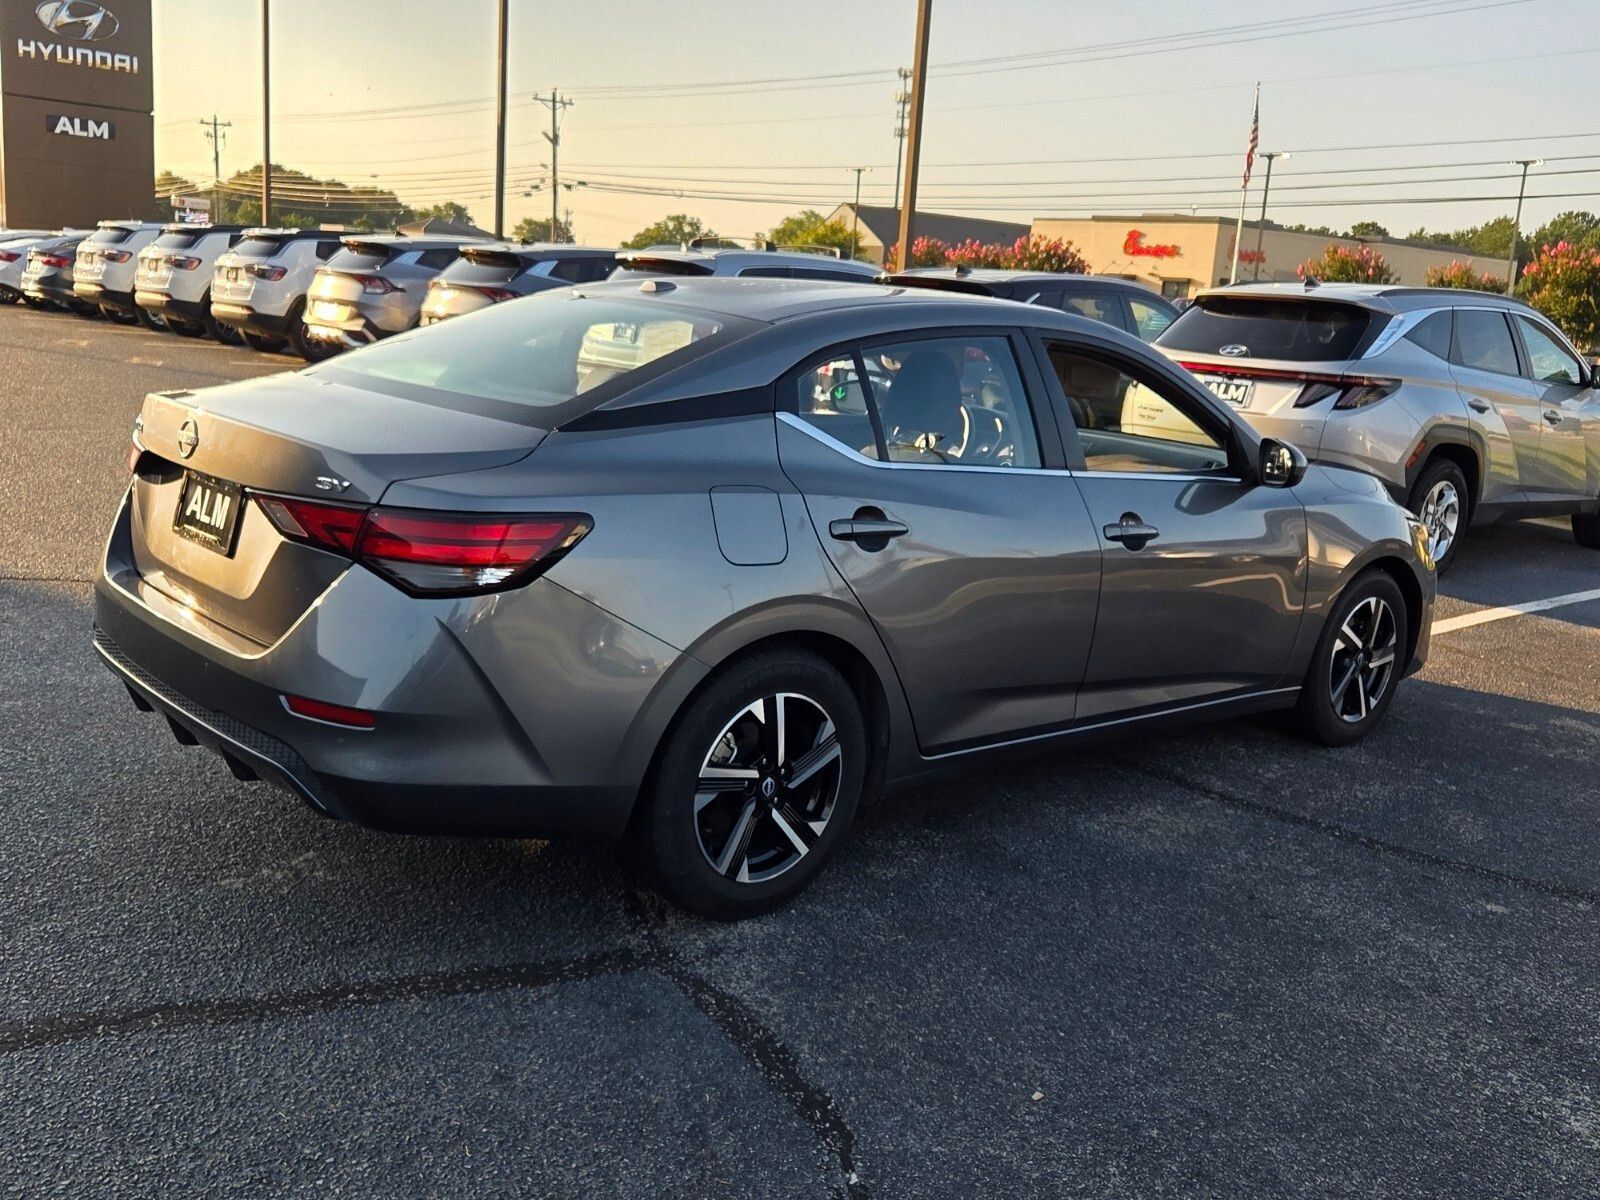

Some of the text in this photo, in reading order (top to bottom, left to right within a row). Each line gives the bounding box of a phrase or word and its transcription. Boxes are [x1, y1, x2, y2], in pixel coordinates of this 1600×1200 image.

[17, 38, 138, 74] HYUNDAI
[54, 115, 109, 140] ALM
[315, 476, 351, 493] SV
[185, 485, 231, 530] ALM
